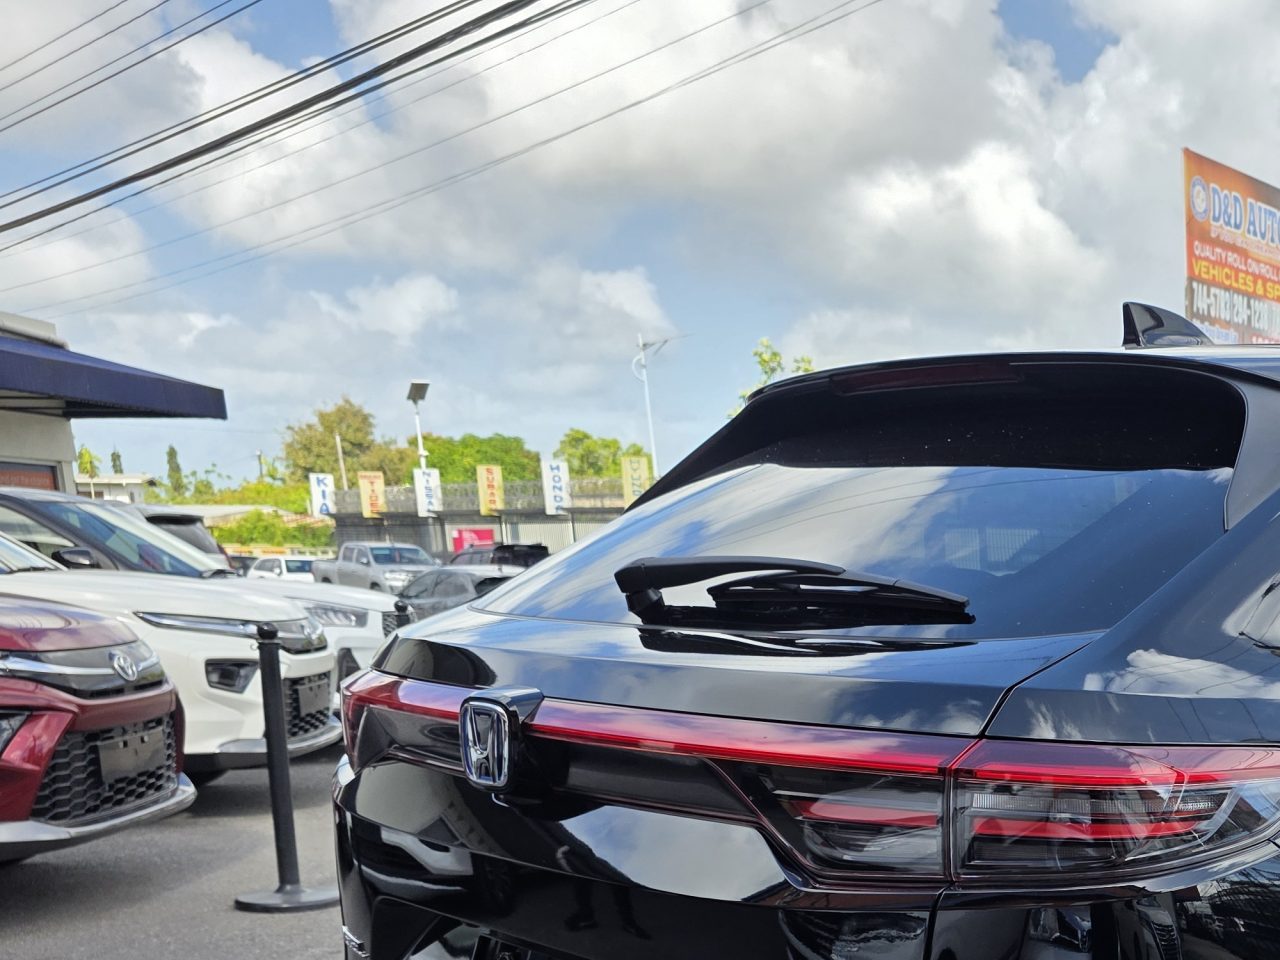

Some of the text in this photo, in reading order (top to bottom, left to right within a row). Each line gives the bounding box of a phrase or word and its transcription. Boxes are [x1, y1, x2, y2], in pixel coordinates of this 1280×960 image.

[1211, 185, 1243, 231] D&D
[1193, 240, 1226, 265] QUALITY
[1227, 252, 1246, 271] ROLL
[1192, 258, 1254, 293] VEHICLES
[1255, 278, 1265, 296] &
[316, 475, 330, 514] KIA
